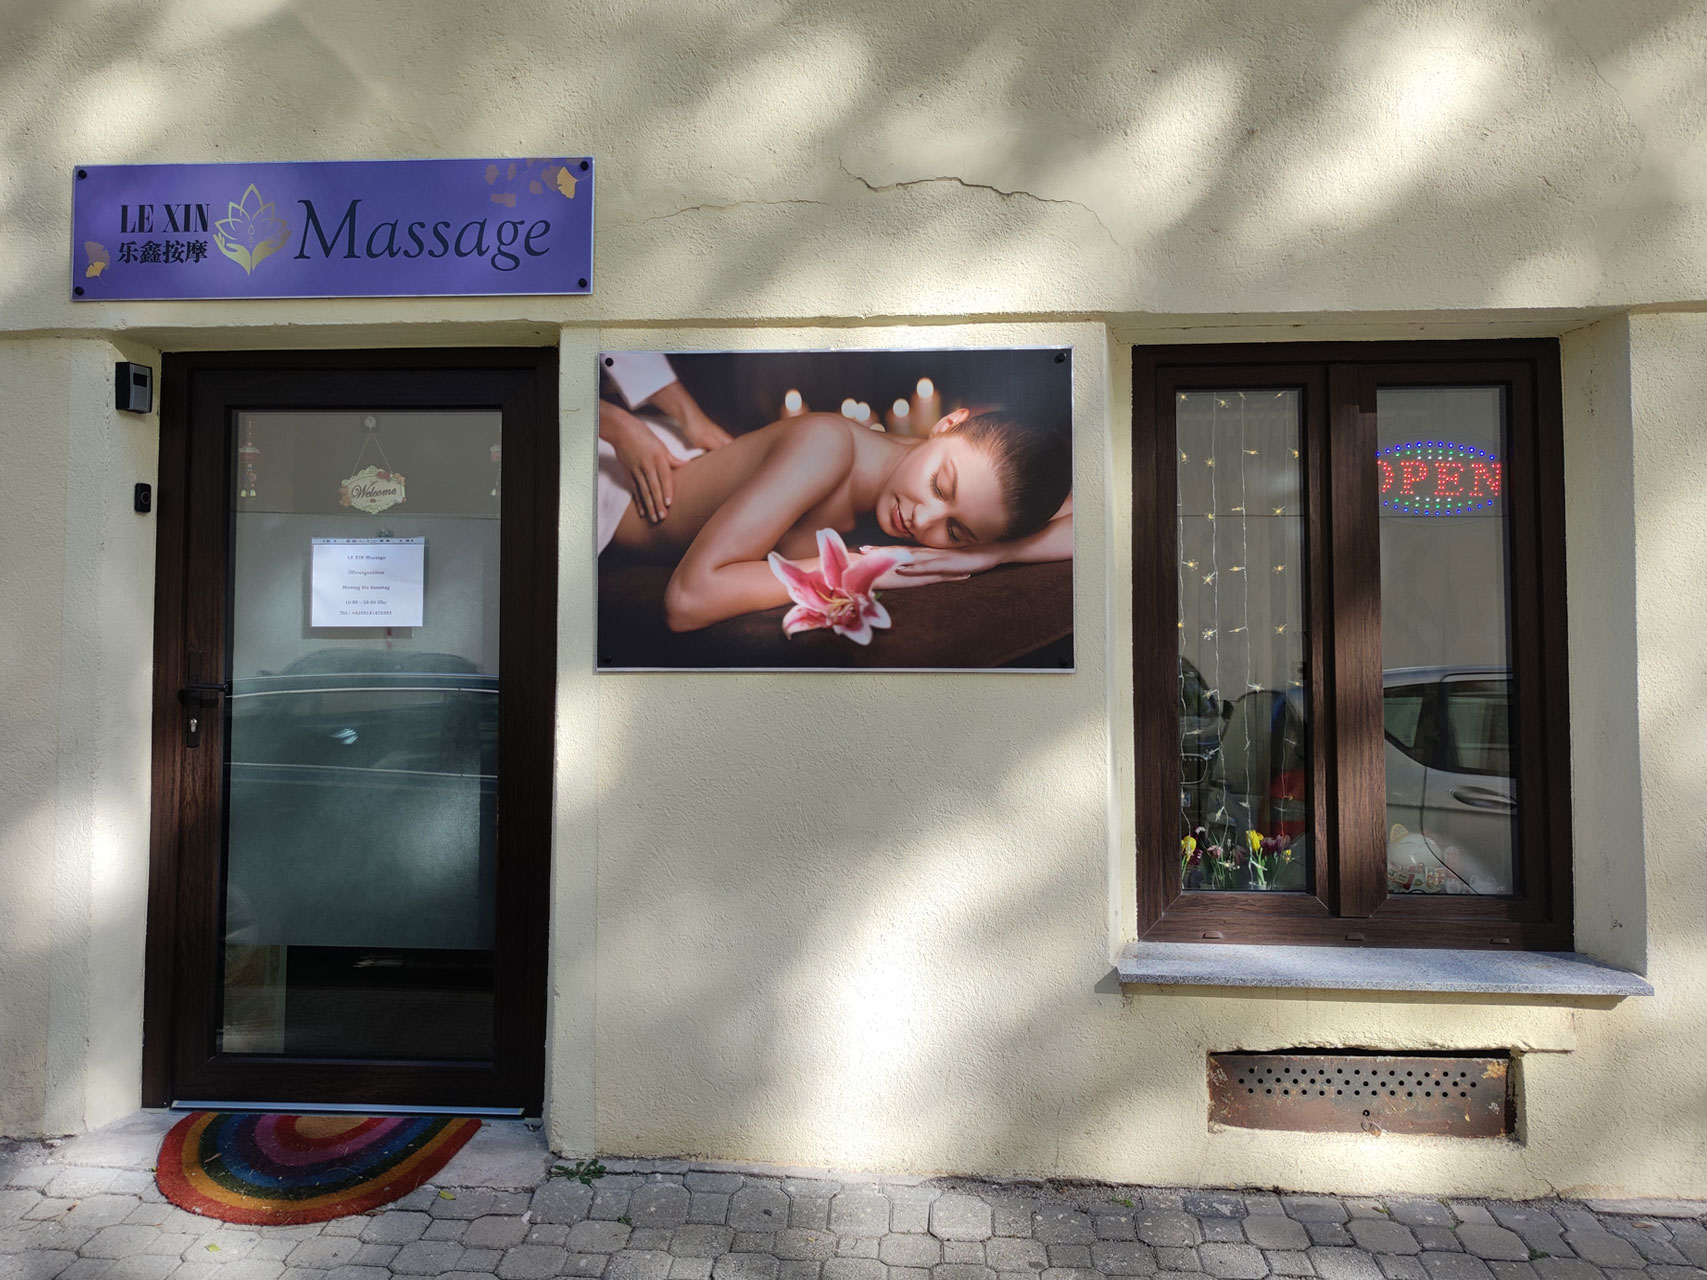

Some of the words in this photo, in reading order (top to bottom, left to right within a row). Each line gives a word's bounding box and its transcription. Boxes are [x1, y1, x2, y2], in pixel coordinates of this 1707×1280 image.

[120, 203, 154, 233] LE
[161, 202, 210, 232] XIN
[294, 199, 551, 271] Massage
[117, 239, 208, 264] 乐鑫按摩
[351, 480, 397, 500] Welcome
